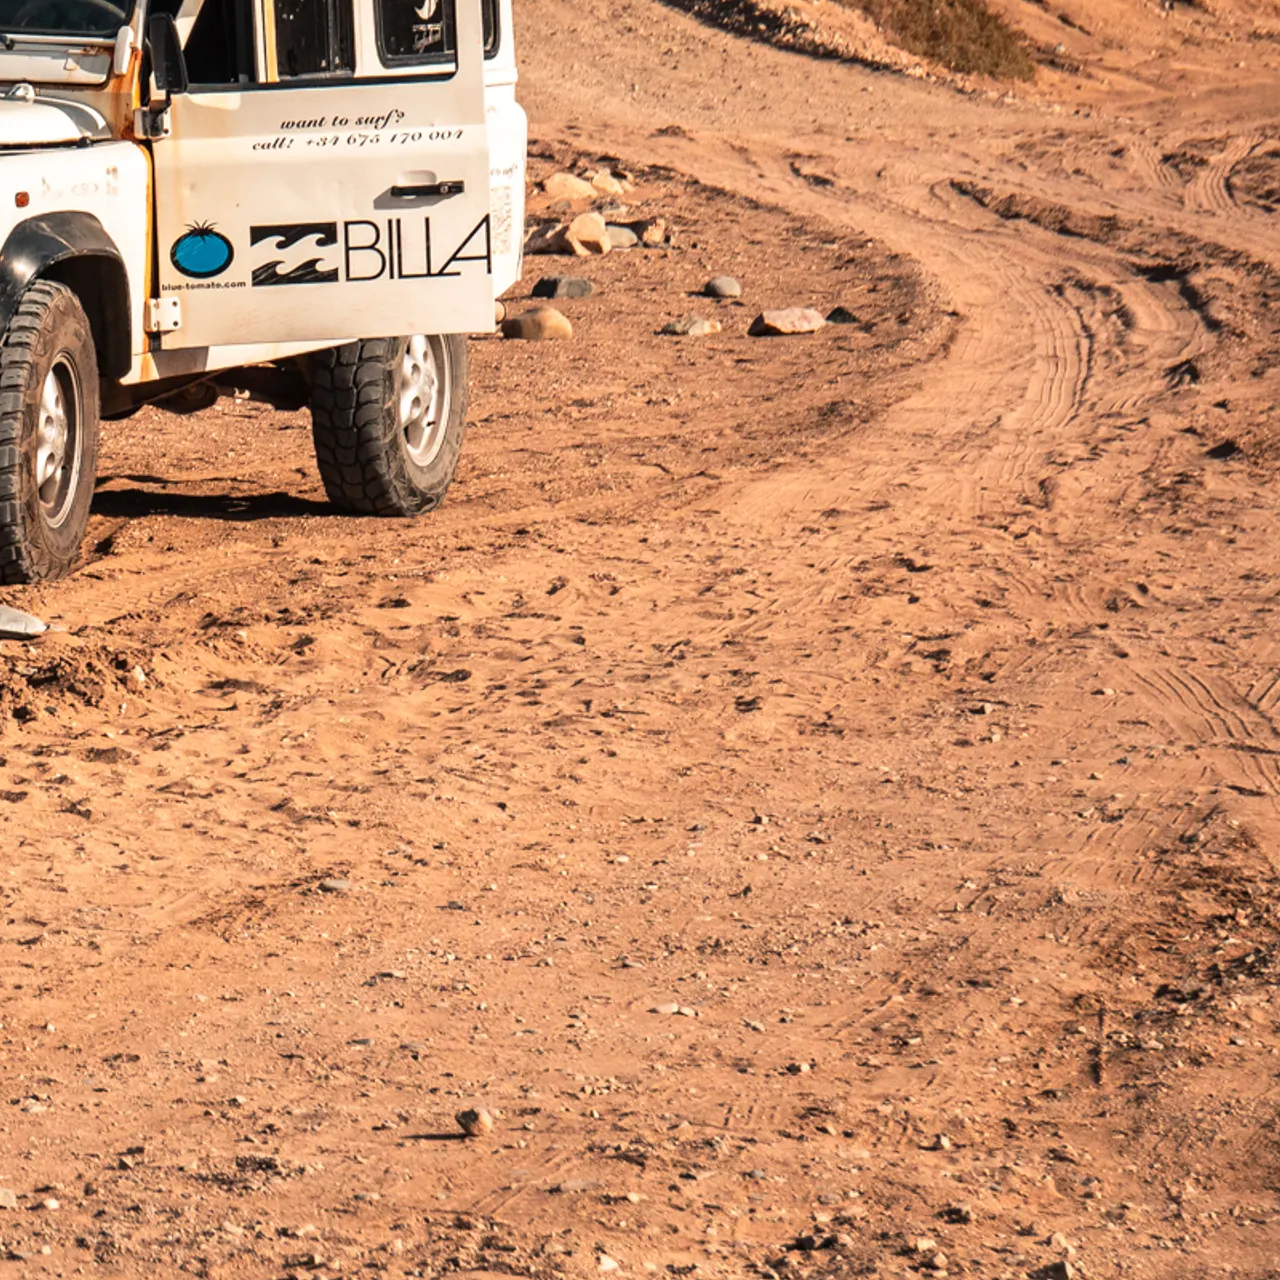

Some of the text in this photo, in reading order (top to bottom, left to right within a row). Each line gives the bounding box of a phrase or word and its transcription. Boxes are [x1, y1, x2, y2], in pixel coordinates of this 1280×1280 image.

[280, 108, 405, 130] want to surf?
[161, 280, 246, 291] blue-tomato.com
